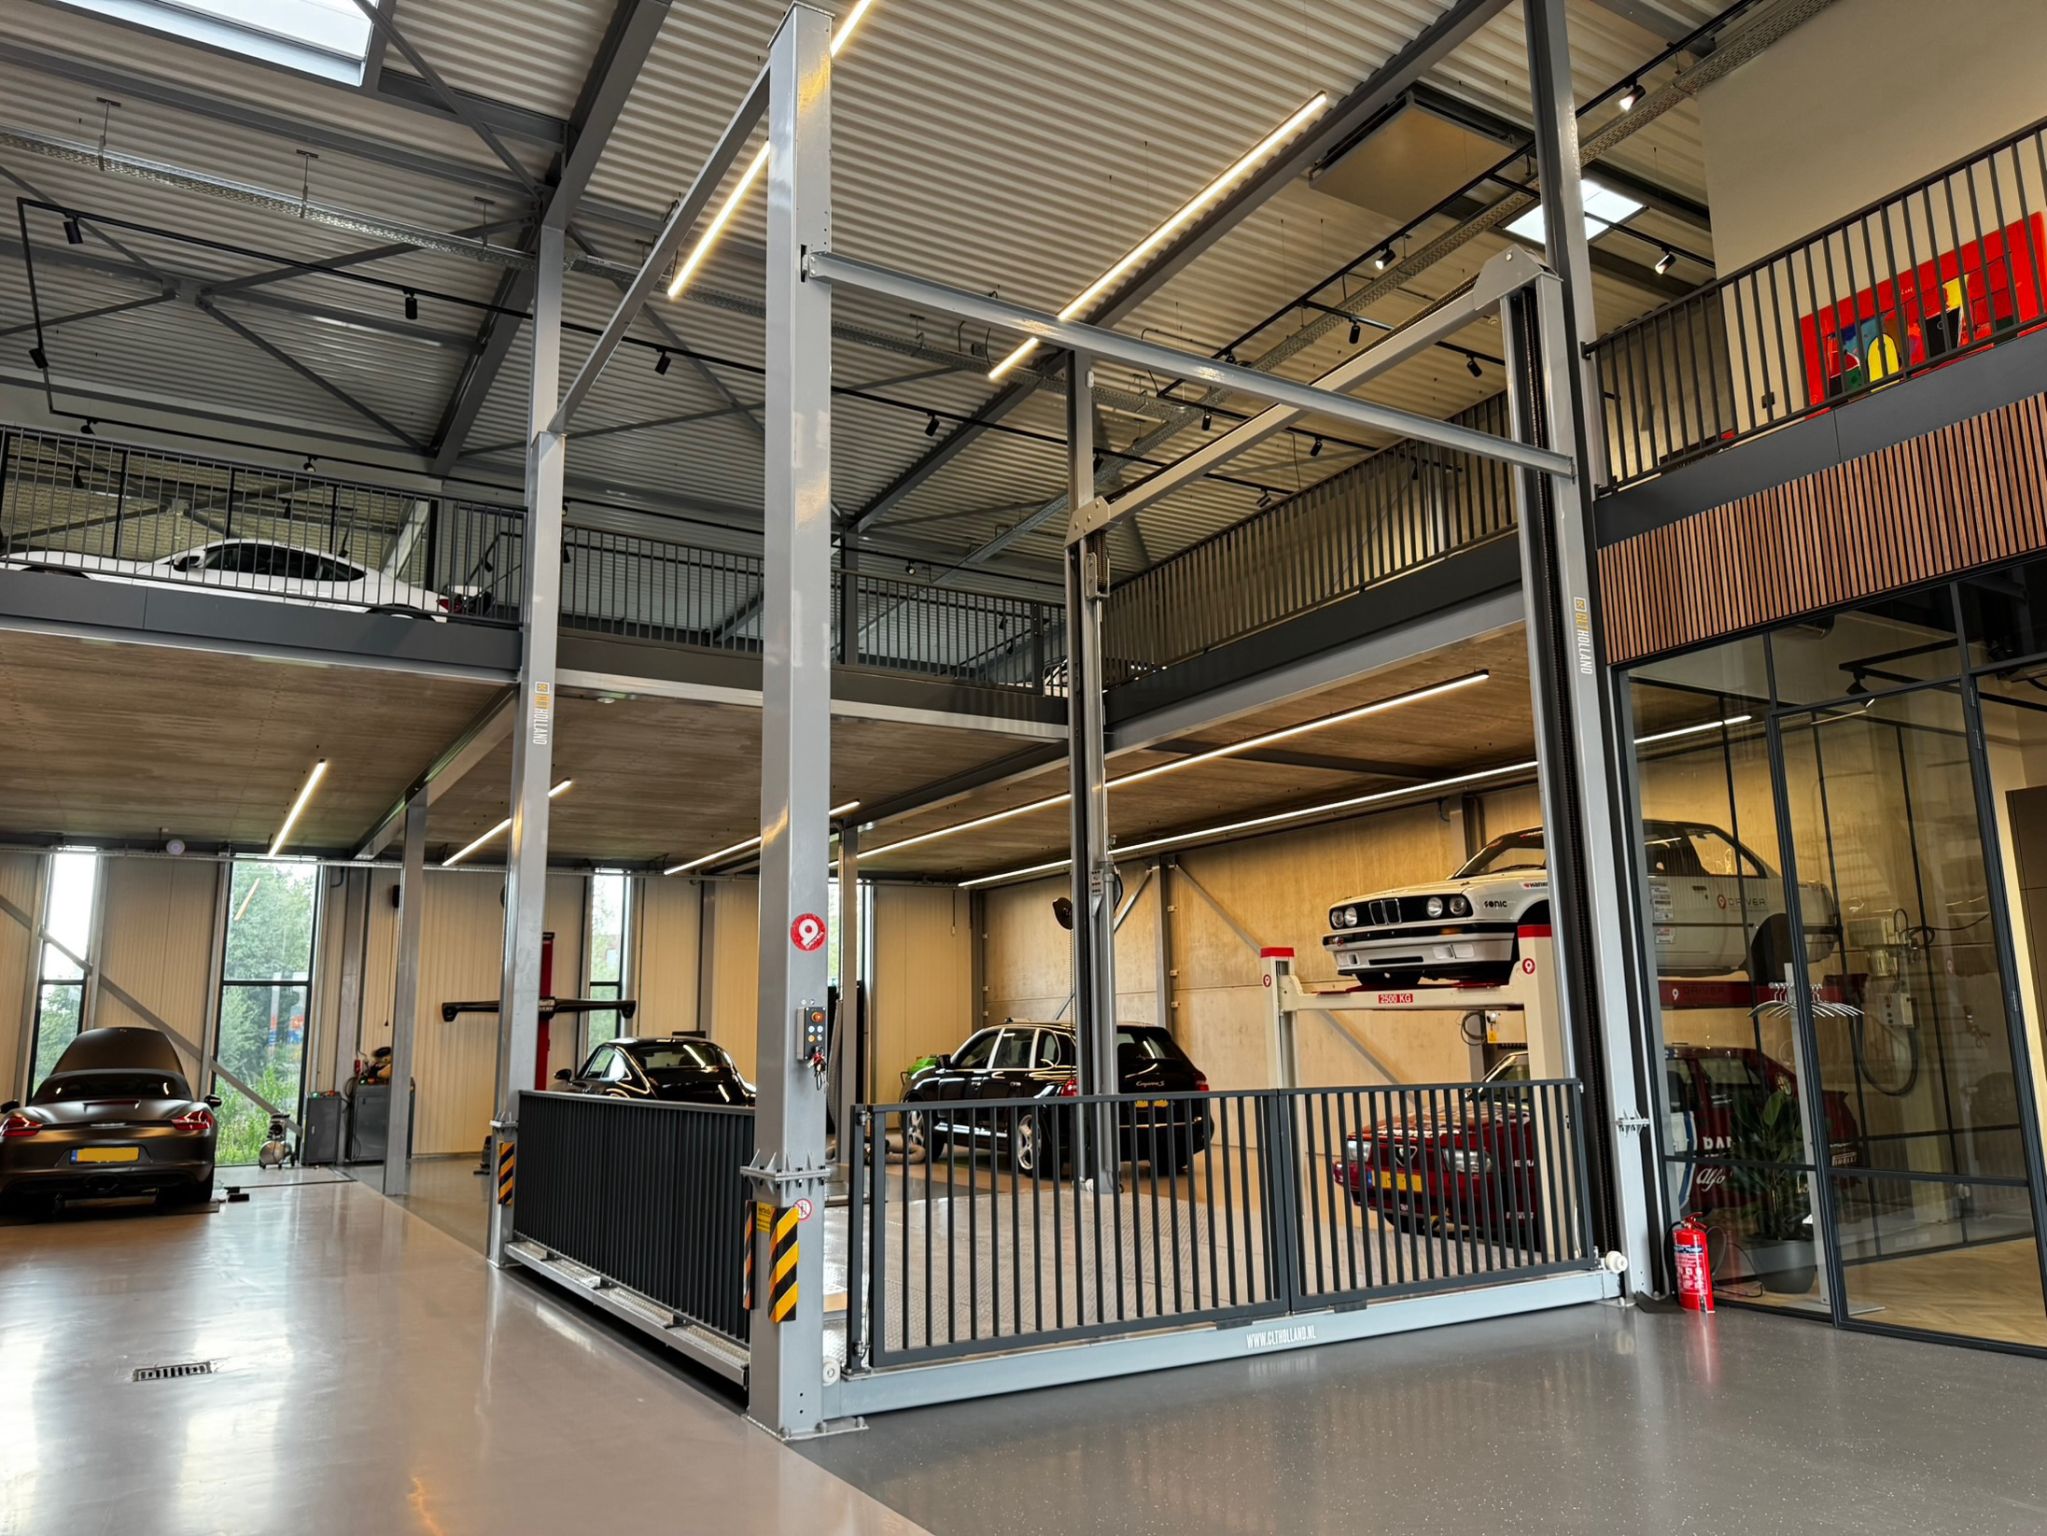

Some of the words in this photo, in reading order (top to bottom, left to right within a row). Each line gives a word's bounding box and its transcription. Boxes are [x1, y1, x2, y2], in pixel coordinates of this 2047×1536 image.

[1728, 897, 1766, 905] DRVER
[1381, 994, 1397, 1003] 2500
[1400, 994, 1411, 1003] KG
